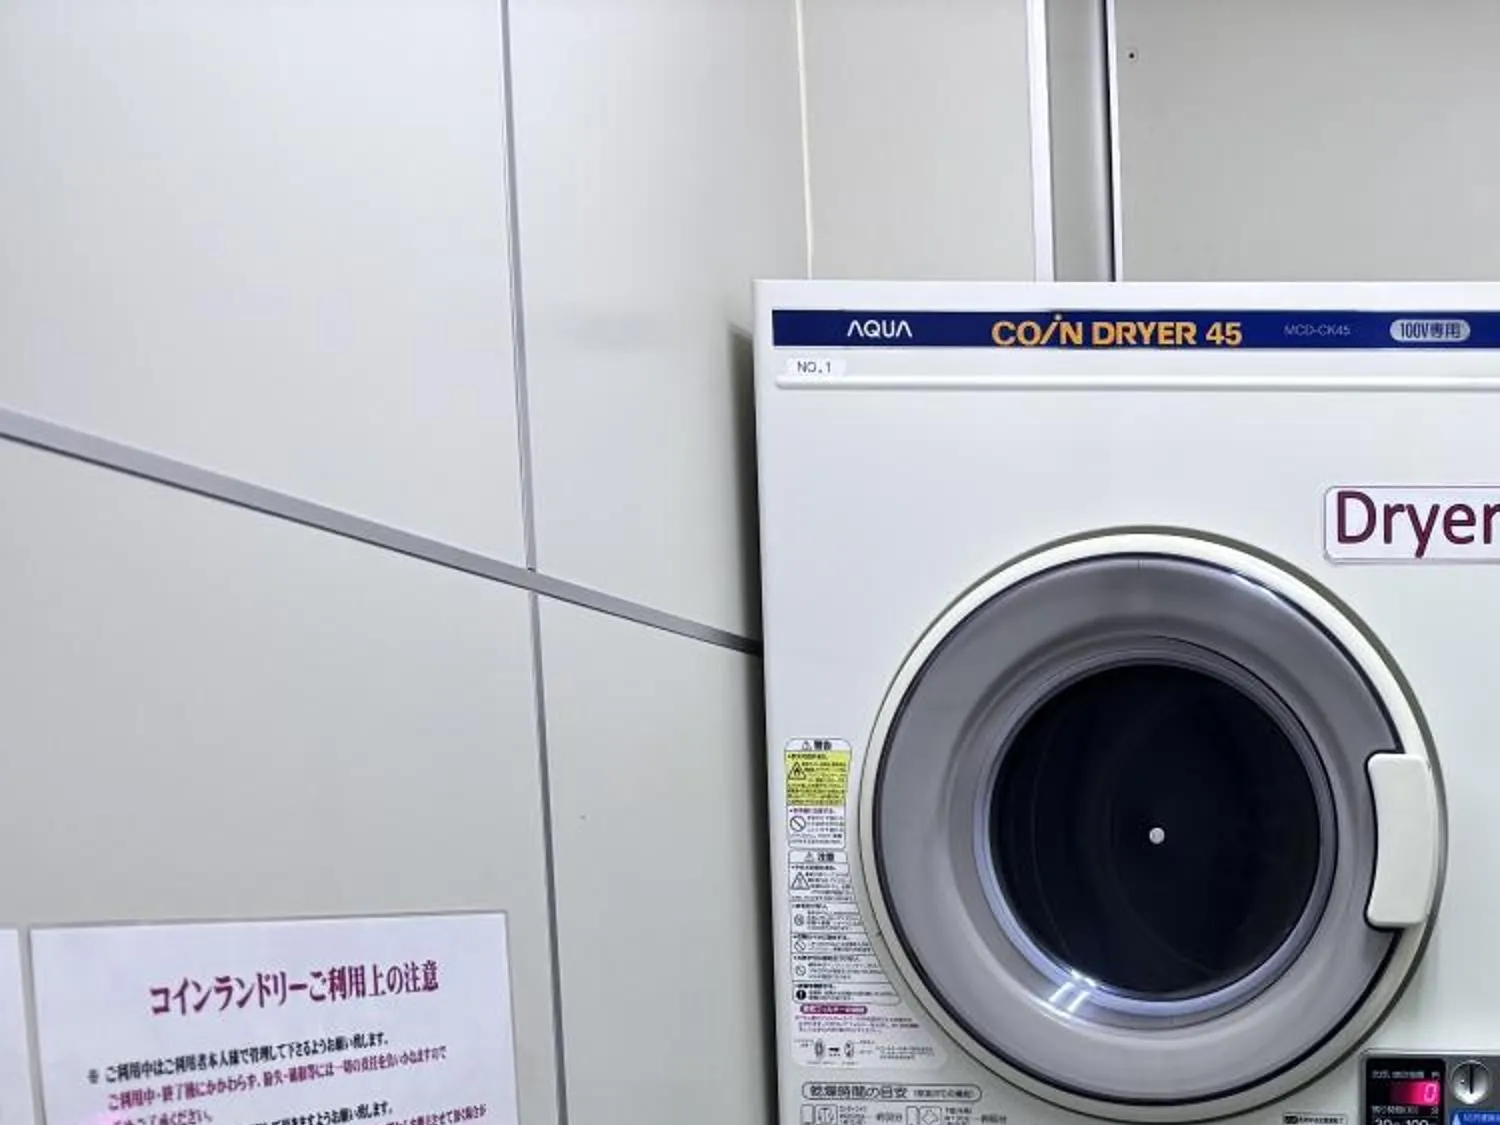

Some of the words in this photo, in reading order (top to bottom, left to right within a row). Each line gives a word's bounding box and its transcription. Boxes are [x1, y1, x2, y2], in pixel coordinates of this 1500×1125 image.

[847, 319, 913, 338] AQUA
[1093, 321, 1197, 346] DRYER
[1205, 320, 1242, 346] 45
[1283, 323, 1352, 337] MCD-CK45
[1398, 319, 1462, 341] 100V専用
[148, 959, 439, 1016] コインランドリーご利用上の注意
[1423, 1083, 1437, 1102] 0
